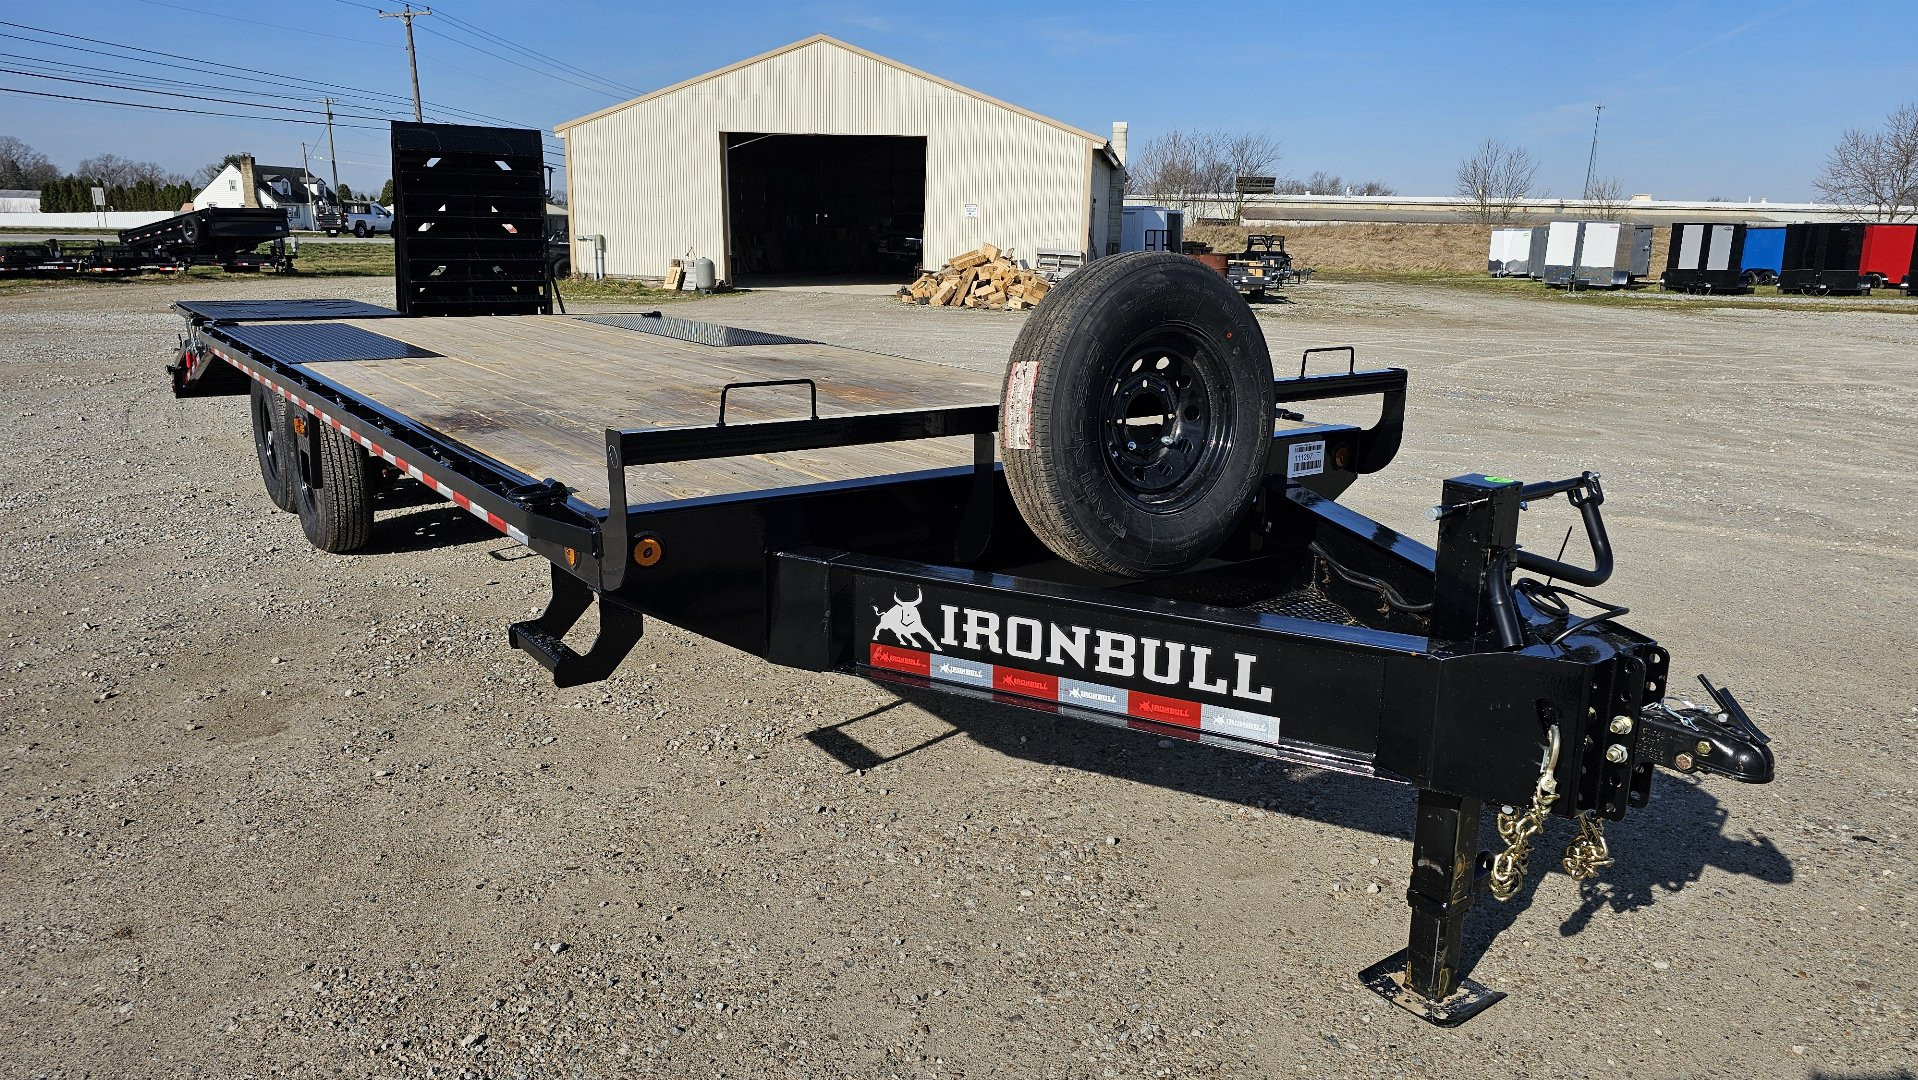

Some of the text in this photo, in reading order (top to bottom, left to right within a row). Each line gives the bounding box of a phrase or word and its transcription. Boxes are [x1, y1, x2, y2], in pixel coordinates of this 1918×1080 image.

[1075, 420, 1127, 538] RADIAL
[1295, 453, 1313, 462] 111297
[940, 604, 1273, 703] IRONBULL
[1151, 704, 1189, 717] IRONBULL
